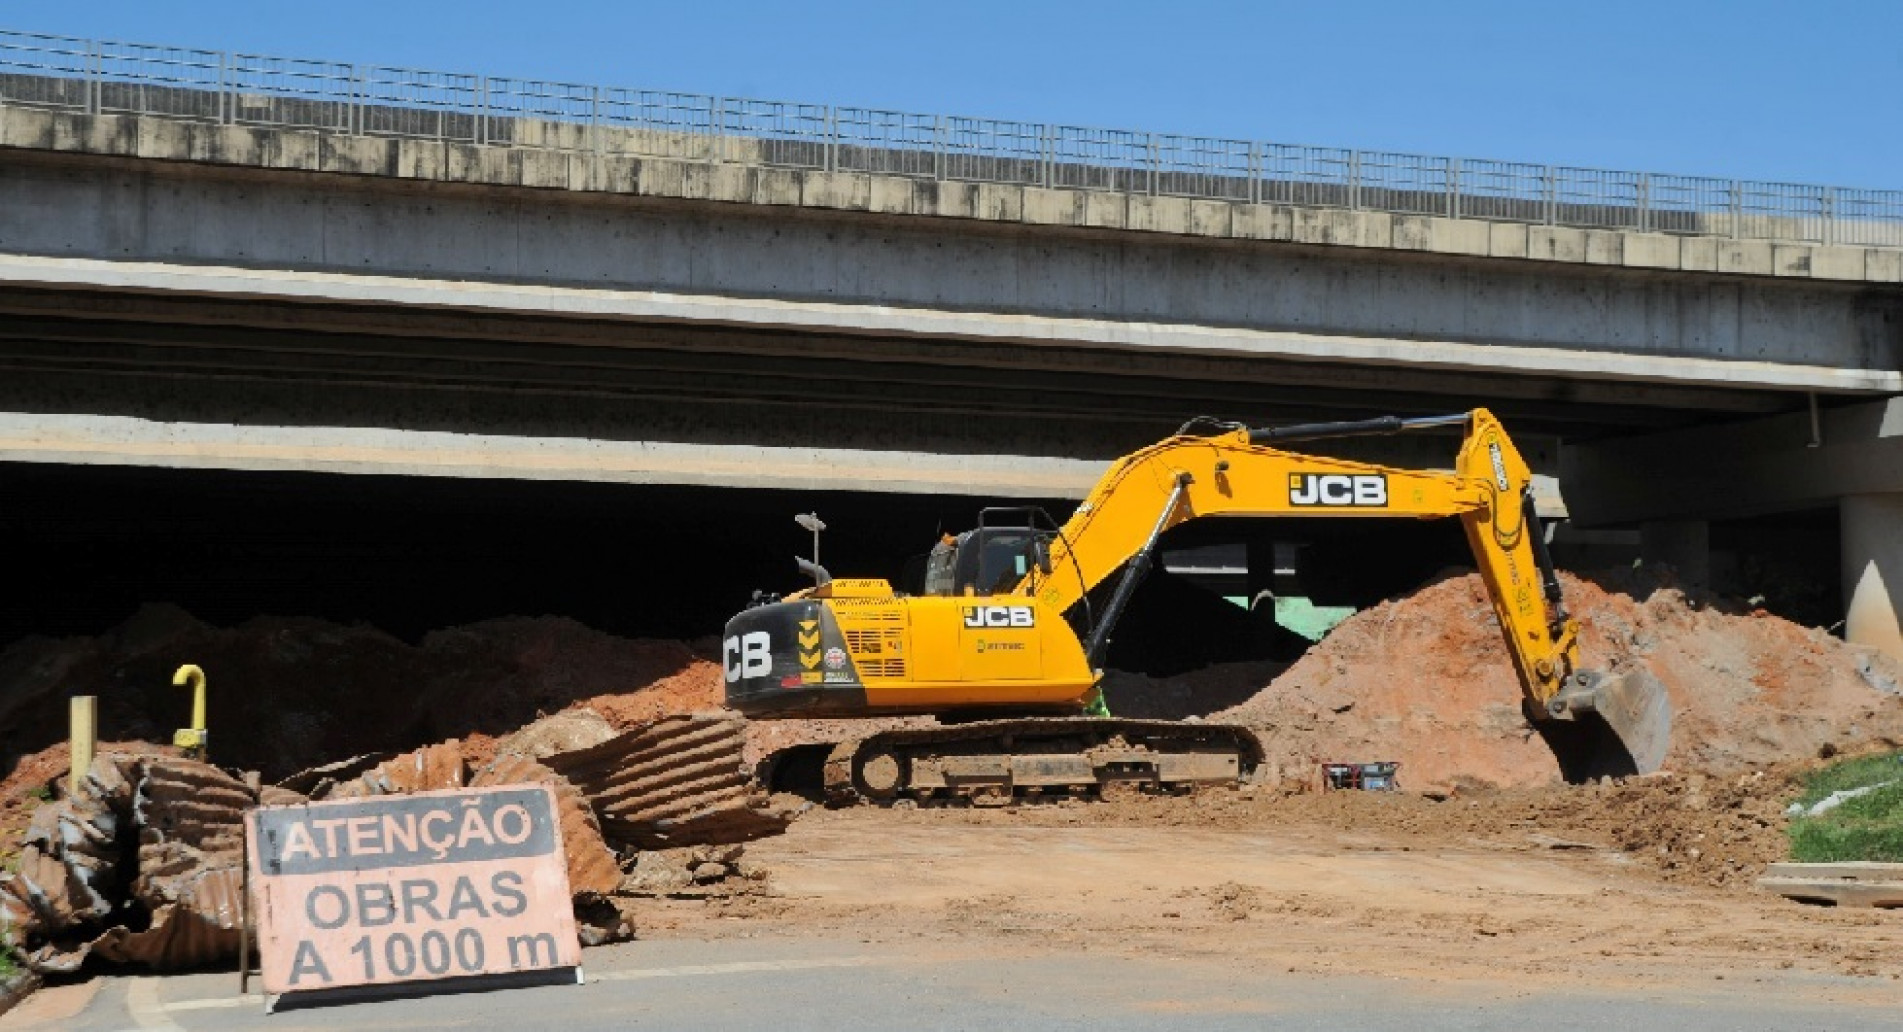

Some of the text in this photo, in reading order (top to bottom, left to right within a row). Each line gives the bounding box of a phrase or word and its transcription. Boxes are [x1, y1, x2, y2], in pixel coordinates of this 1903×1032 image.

[1290, 474, 1387, 505] JCB
[963, 606, 1033, 627] JCB
[723, 631, 772, 682] CB
[280, 798, 533, 862] ATENÇÃO
[306, 870, 528, 930] OBRAS
[288, 927, 559, 985] A 1000 m
